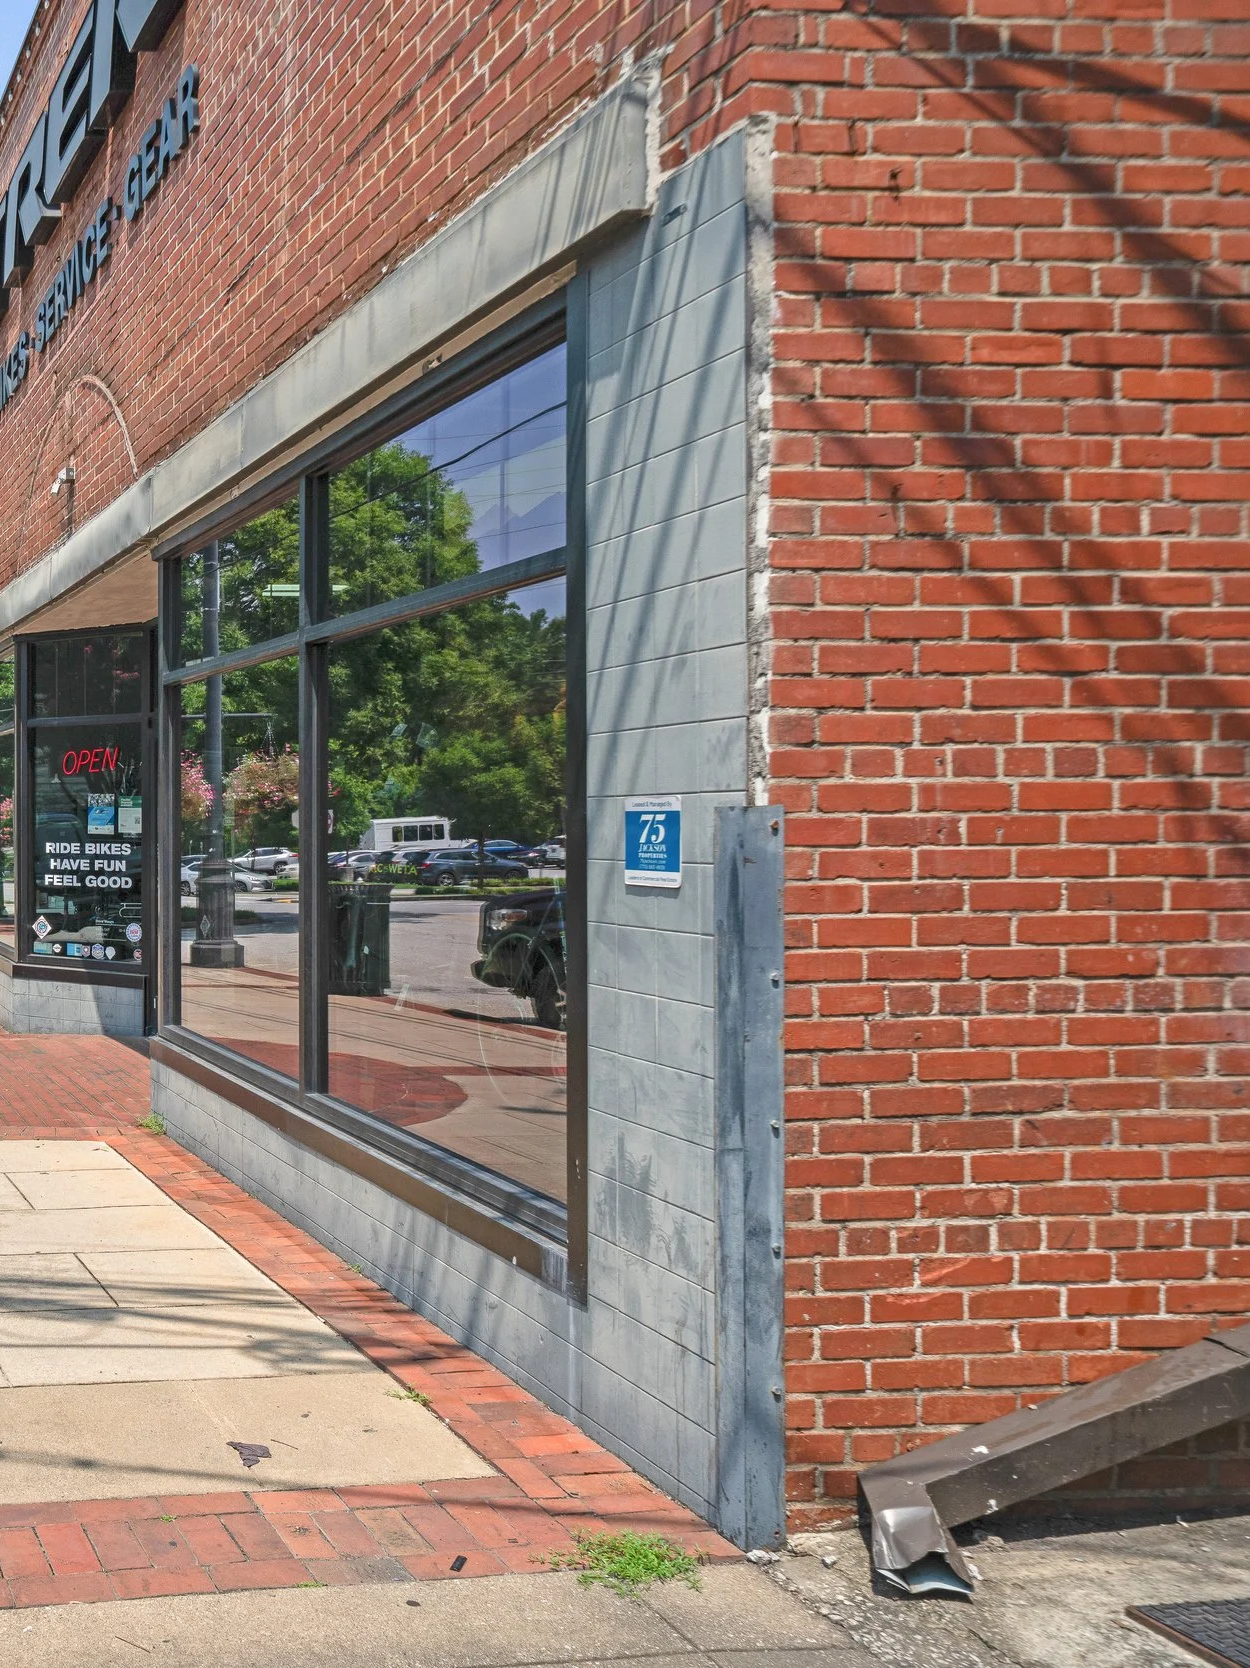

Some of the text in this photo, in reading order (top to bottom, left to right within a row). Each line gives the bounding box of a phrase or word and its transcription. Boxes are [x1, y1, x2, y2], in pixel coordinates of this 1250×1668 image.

[34, 197, 113, 353] SERVICE
[123, 63, 199, 222] GEAR
[62, 746, 119, 776] OPEN
[639, 814, 666, 844] 75
[45, 842, 131, 855] RIDE BIKES
[638, 844, 666, 852] JACKSON
[50, 858, 126, 872] HAVE FUN
[44, 874, 132, 888] FEEL GOOD
